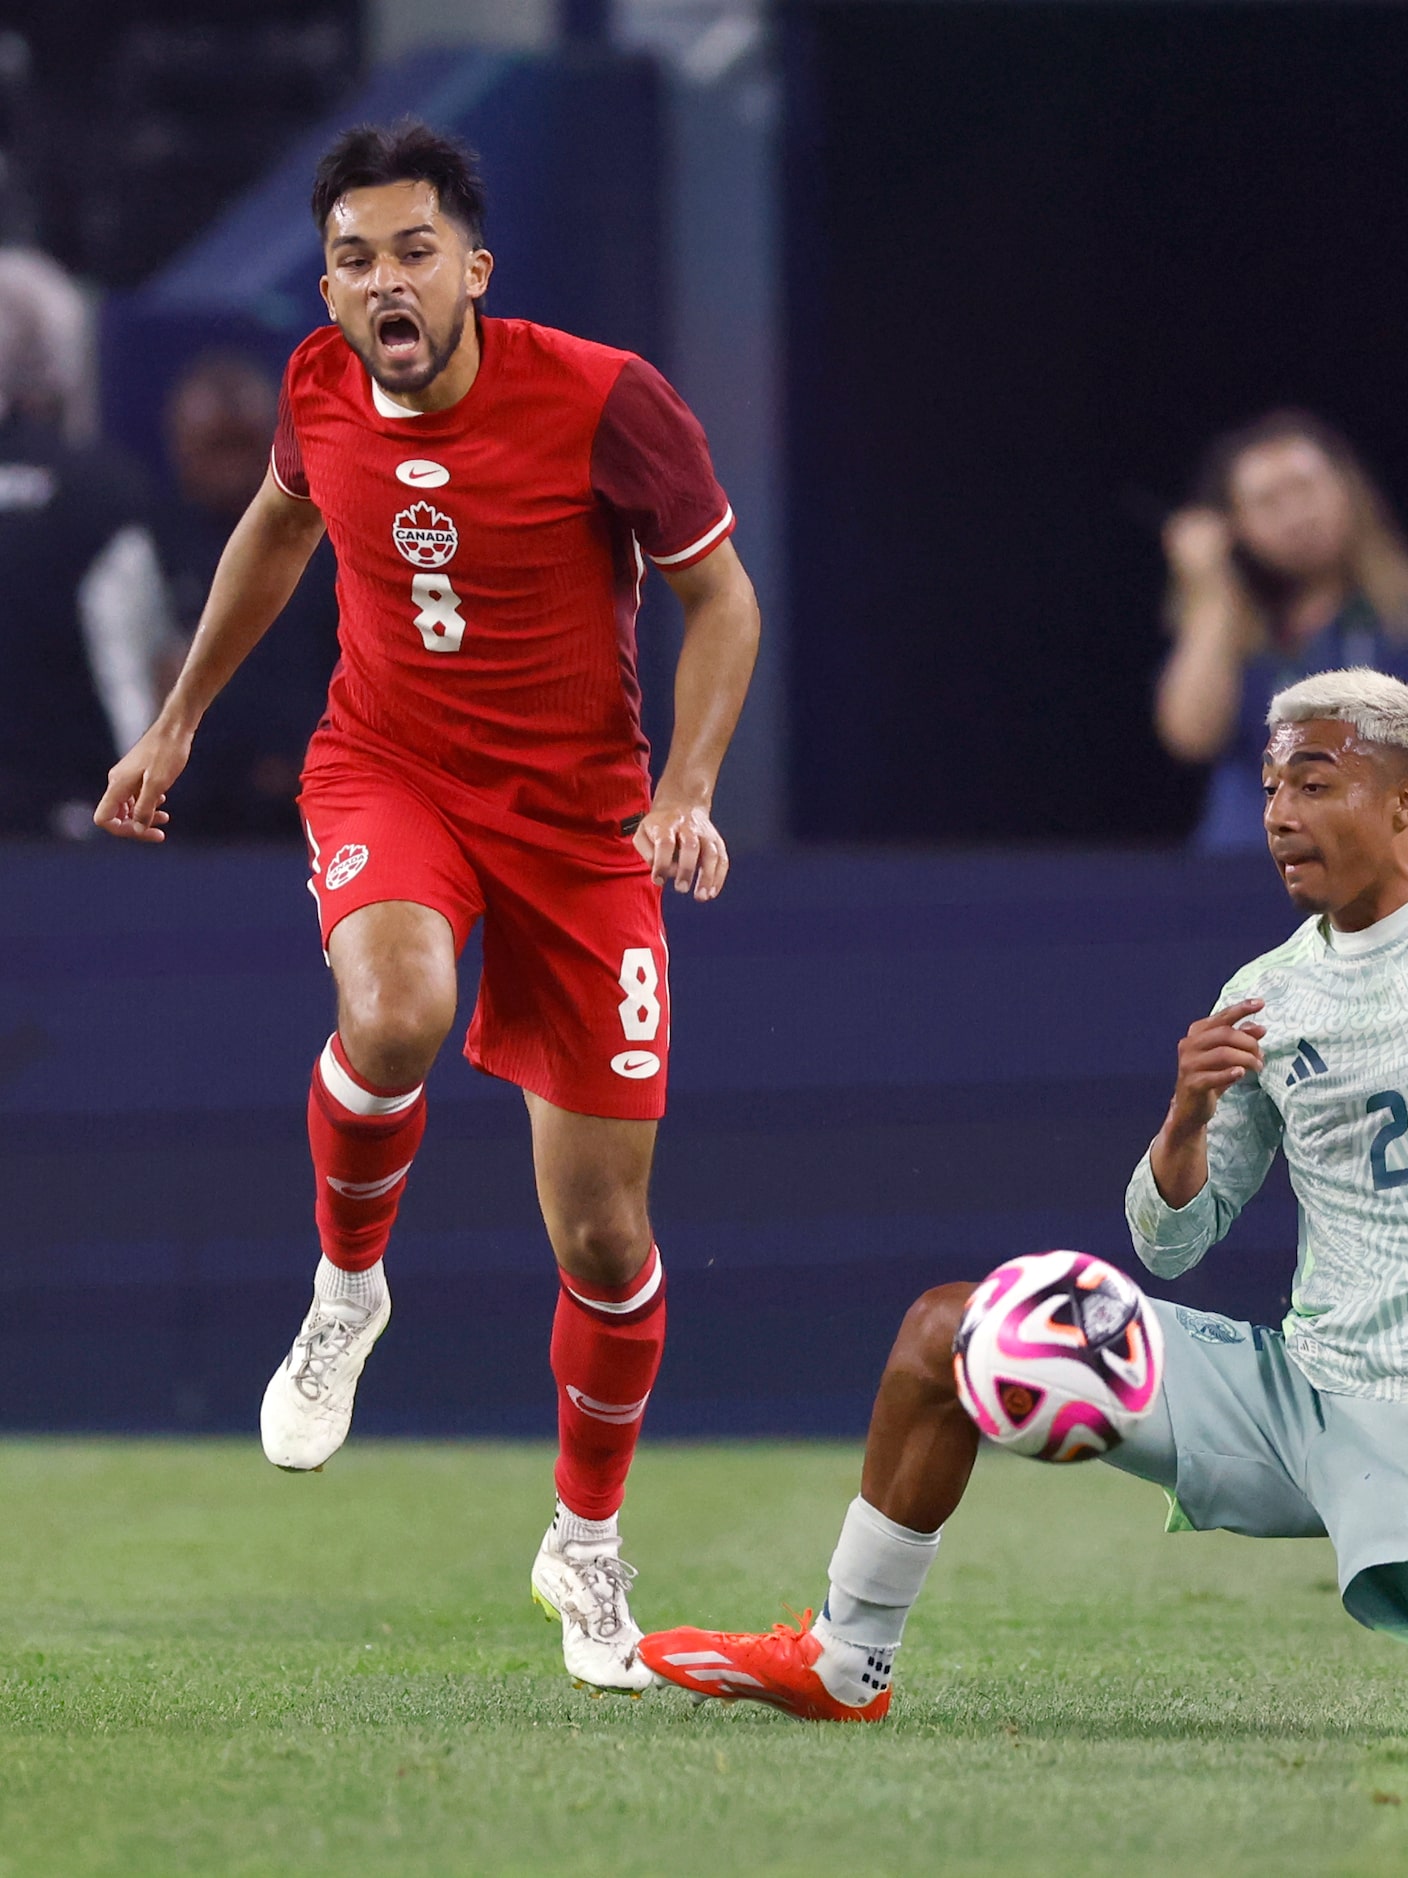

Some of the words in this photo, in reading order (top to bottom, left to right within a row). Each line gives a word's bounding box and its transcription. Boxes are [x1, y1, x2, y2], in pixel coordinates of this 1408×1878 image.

[396, 529, 454, 543] CANADA
[411, 574, 466, 652] 8
[327, 854, 365, 881] ANADA
[618, 947, 661, 1041] 8
